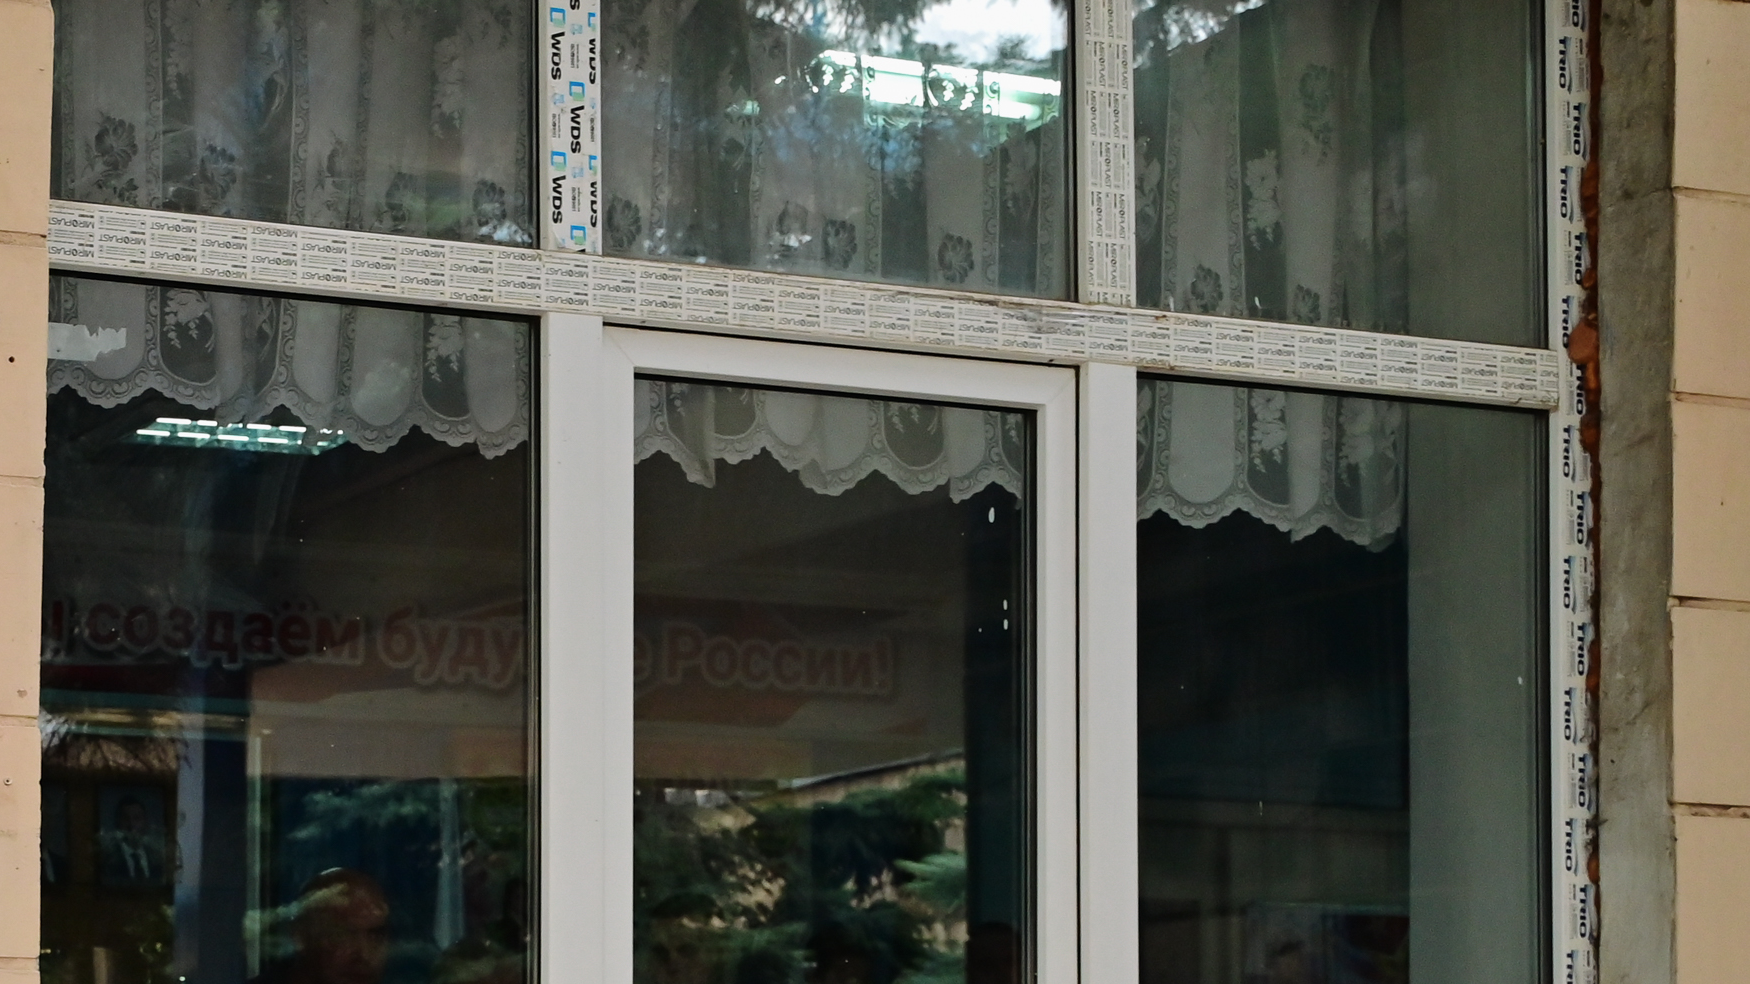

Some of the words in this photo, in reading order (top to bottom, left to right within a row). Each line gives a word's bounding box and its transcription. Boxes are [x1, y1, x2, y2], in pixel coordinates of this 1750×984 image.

[551, 32, 566, 80] WDS
[1559, 37, 1568, 89] TRIO
[570, 106, 584, 154] WDS
[1573, 103, 1582, 155] TRIO
[1560, 166, 1568, 219] TRIO
[551, 175, 566, 224] WDS
[149, 221, 196, 233] MIROPLAST
[98, 233, 145, 245] MIROPLAST
[200, 237, 246, 250] MIROPLAST
[250, 254, 296, 266] MIROPLAST
[350, 258, 395, 270] MIROPLAST
[1574, 233, 1583, 285] TRIO
[200, 266, 246, 278] MIROPLAST
[300, 270, 346, 282] MIROPLAST
[543, 266, 588, 278] MIROPLAST
[399, 274, 444, 286] MIROPLAST
[497, 278, 540, 290] MIROPLAST
[591, 282, 635, 293] MIROPLAST
[685, 285, 728, 297] MIROPLAST
[449, 290, 493, 302] MIROPLAST
[638, 298, 682, 309] MIROPLAST
[732, 301, 774, 312] MIROPLAST
[823, 304, 865, 315] MIROPLAST
[777, 316, 820, 327] MIROPLAST
[1562, 296, 1570, 348] TRIO
[1563, 425, 1572, 478] TRIO
[1577, 492, 1586, 545] TRIO
[1577, 622, 1586, 676] TRIO
[1564, 688, 1572, 741] TRIO
[1579, 754, 1588, 808] TRIO
[1565, 819, 1573, 872] TRIO
[1580, 884, 1588, 939] TRIO
